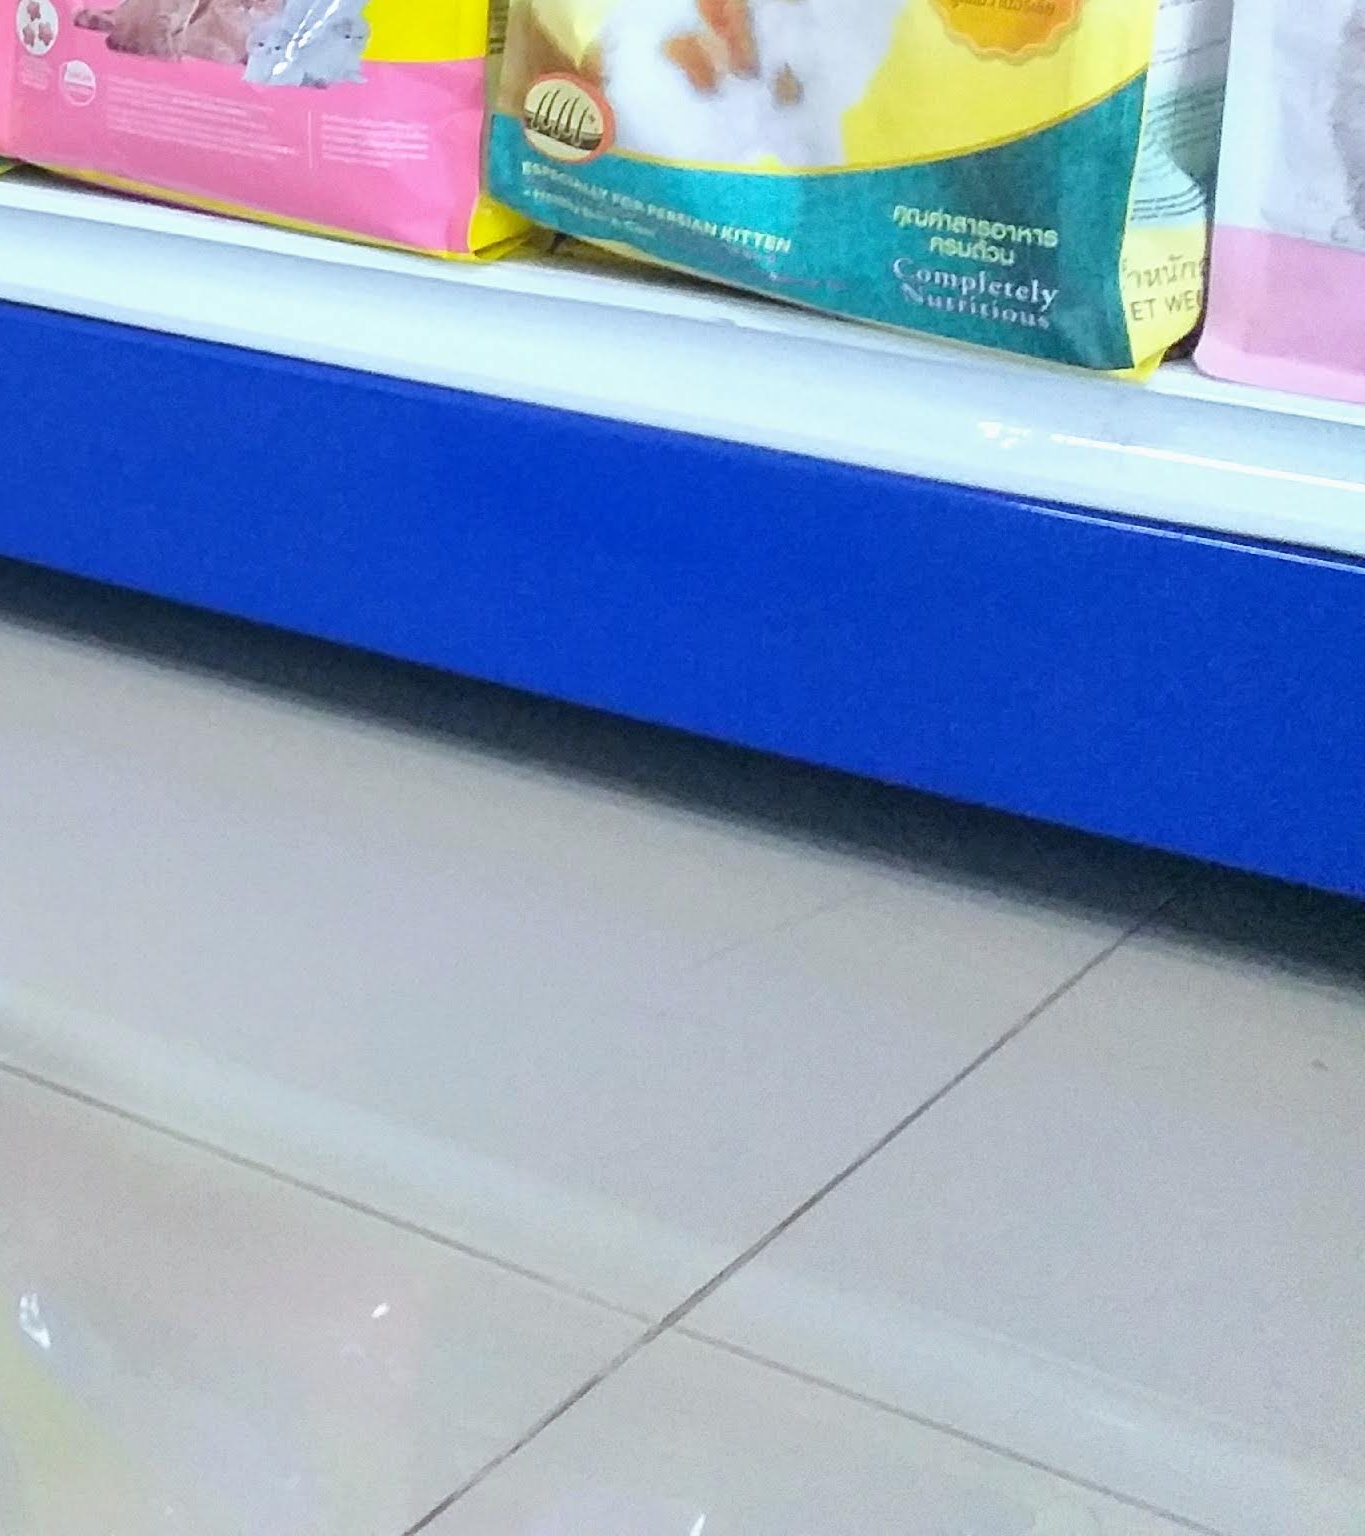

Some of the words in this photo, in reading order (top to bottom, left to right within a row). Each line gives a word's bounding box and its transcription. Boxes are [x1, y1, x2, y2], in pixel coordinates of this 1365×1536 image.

[720, 225, 792, 254] KITTEN
[893, 257, 1060, 312] Completely
[900, 282, 1051, 331] Nutritious
[1130, 297, 1159, 323] ET
